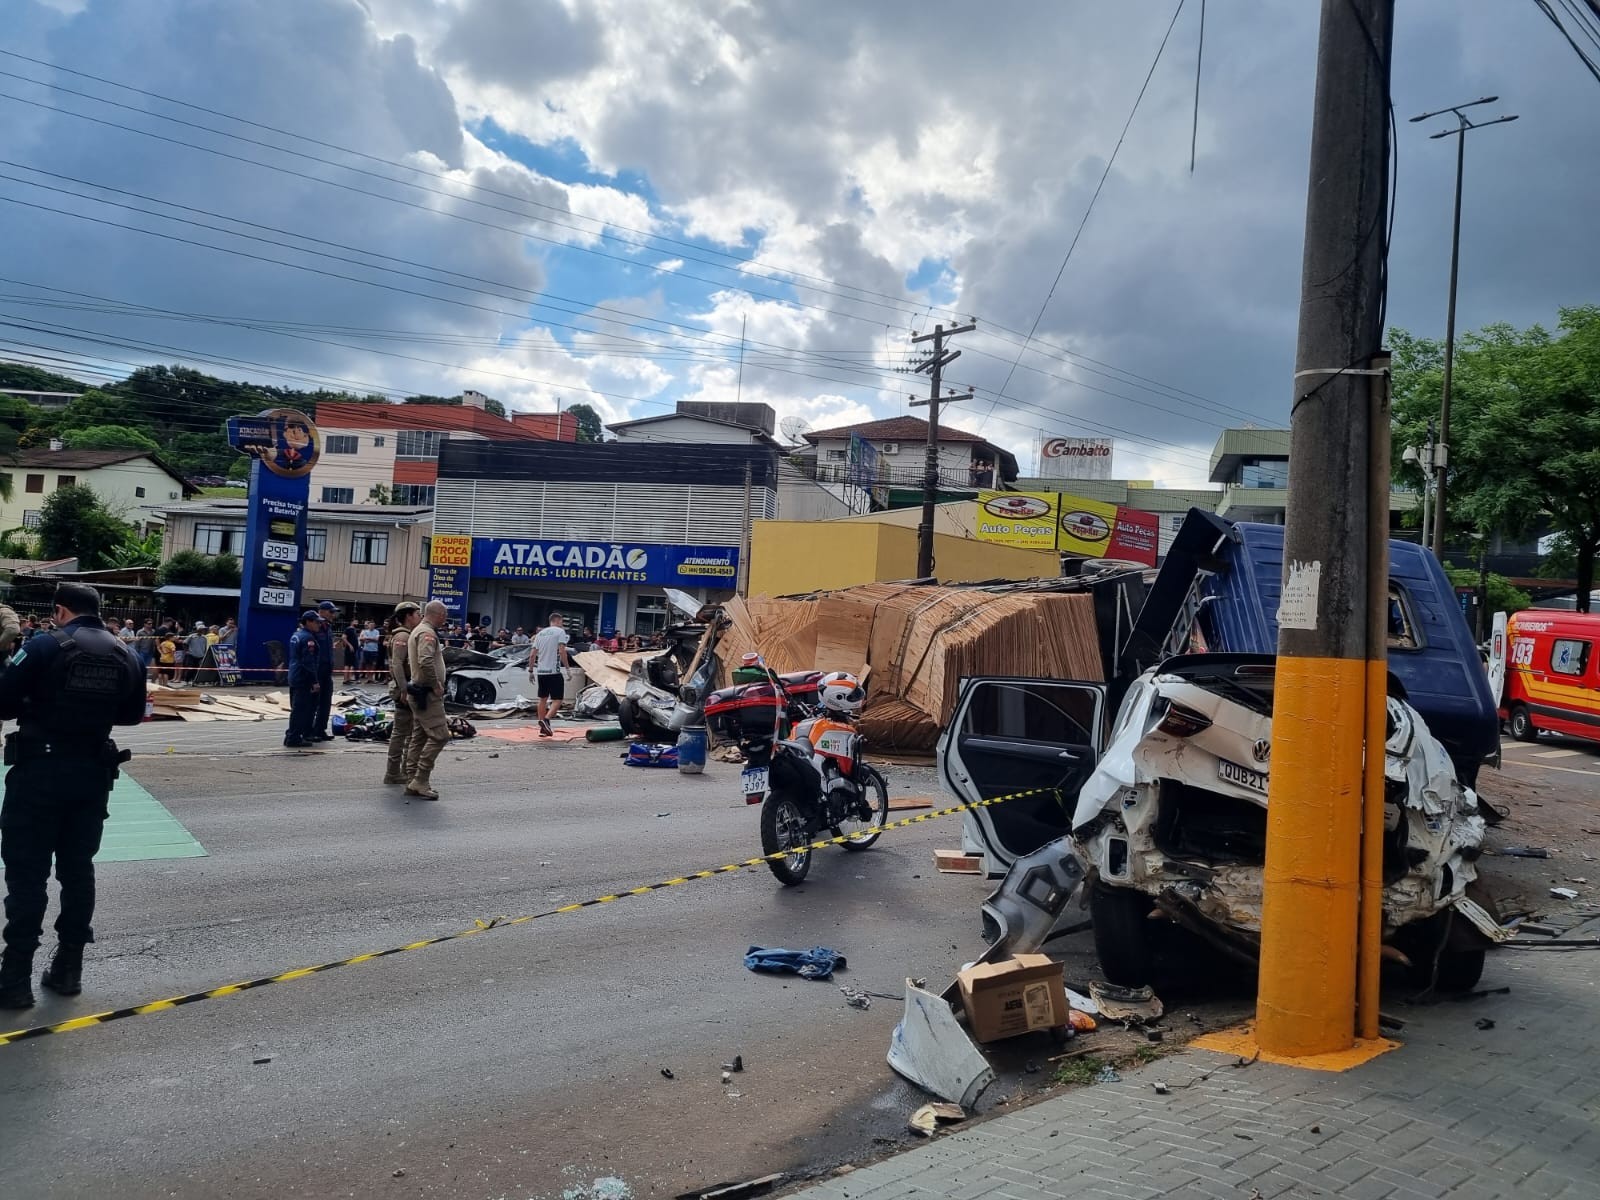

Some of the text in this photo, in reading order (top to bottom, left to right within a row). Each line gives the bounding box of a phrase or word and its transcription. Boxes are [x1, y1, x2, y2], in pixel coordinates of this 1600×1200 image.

[263, 498, 286, 507] Precisa
[981, 523, 1054, 537] Auto Peças
[1117, 522, 1154, 537] Auto Peças
[441, 537, 470, 546] SUPER
[266, 545, 288, 559] 299
[434, 546, 468, 555] TROCA
[494, 543, 648, 570] ATACADÃO
[440, 555, 468, 565] ÓLEO
[684, 557, 730, 566] ATENDIMENTO
[493, 566, 647, 582] BATERIAS LUBRIFICANTES
[262, 591, 285, 604] 249
[1511, 643, 1534, 665] 193
[74, 666, 119, 679] GUARDA
[747, 773, 763, 782] TPJ
[744, 781, 765, 792] 3J97
